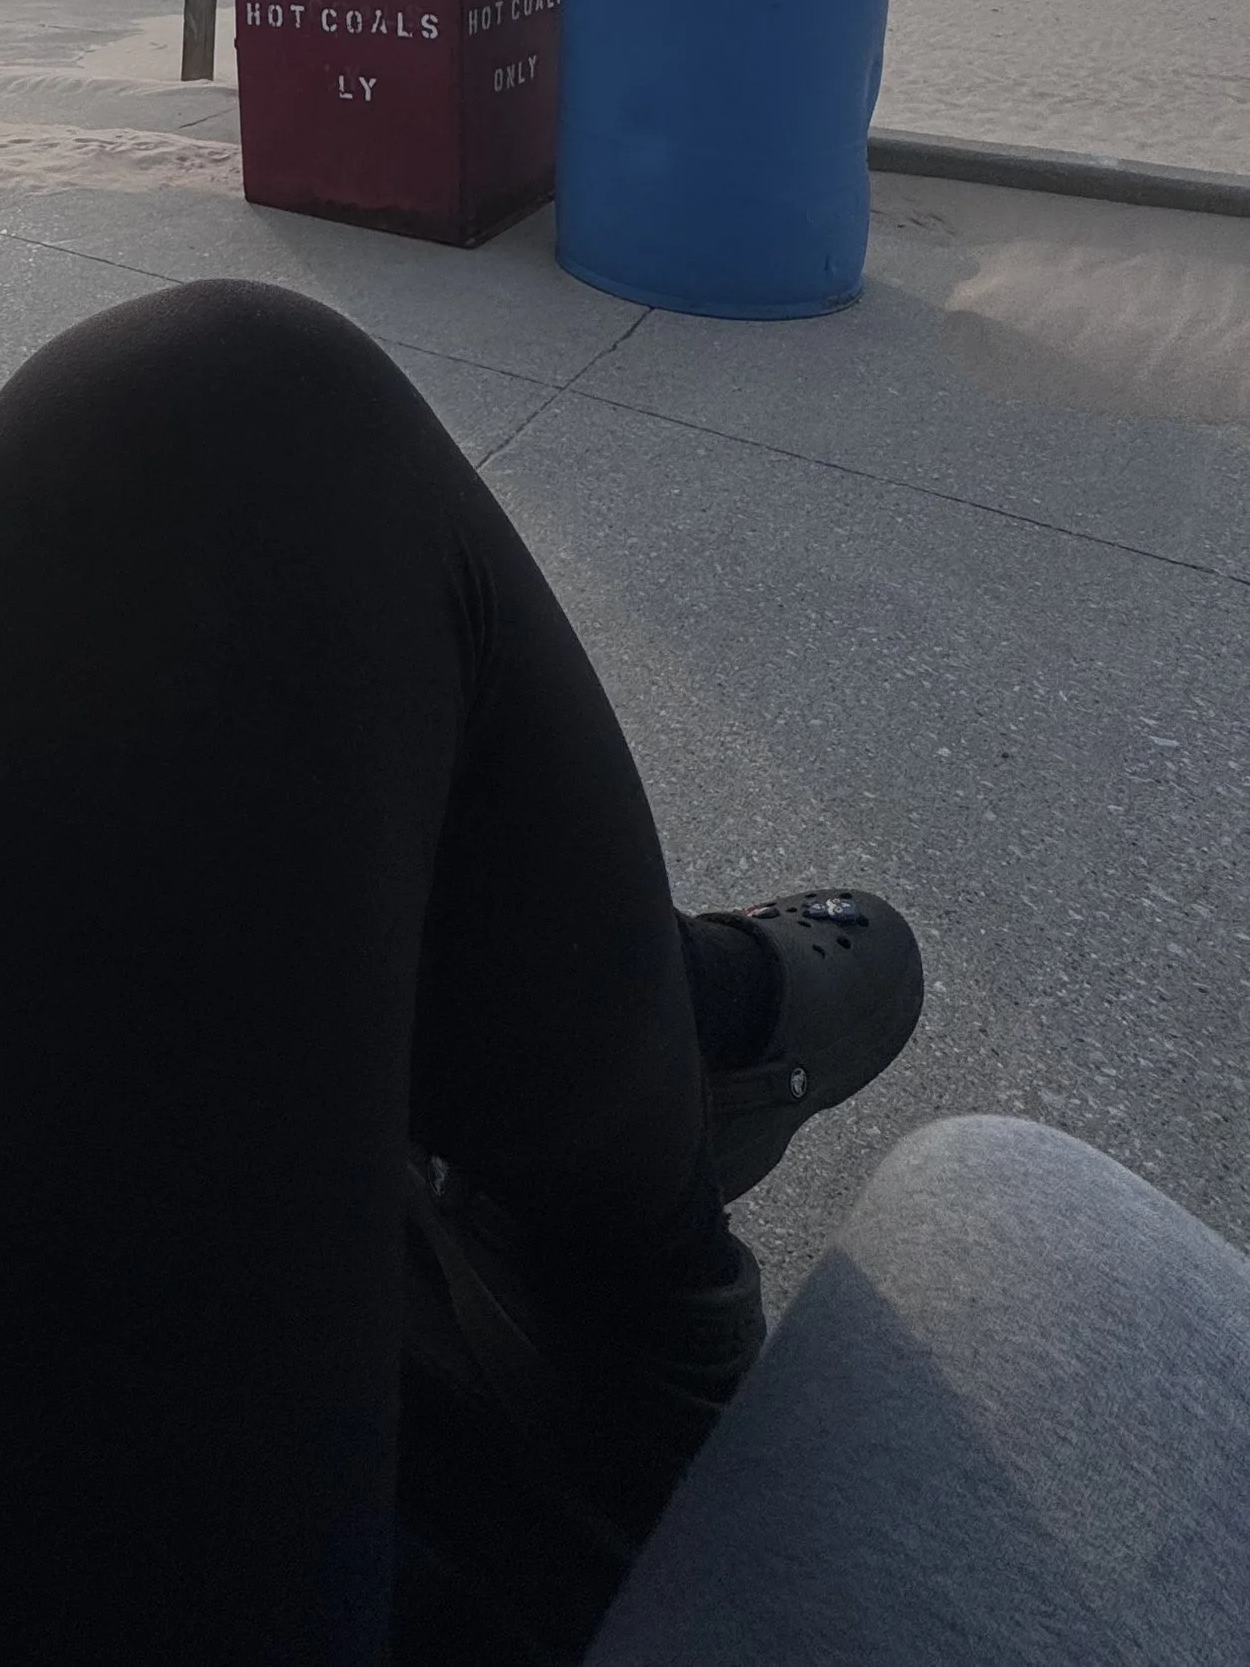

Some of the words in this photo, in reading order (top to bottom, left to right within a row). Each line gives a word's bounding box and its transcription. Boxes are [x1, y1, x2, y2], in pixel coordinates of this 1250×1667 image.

[246, 2, 305, 29] HOT
[321, 9, 439, 40] COALS
[468, 0, 504, 36] HOT
[493, 54, 538, 92] ONLY
